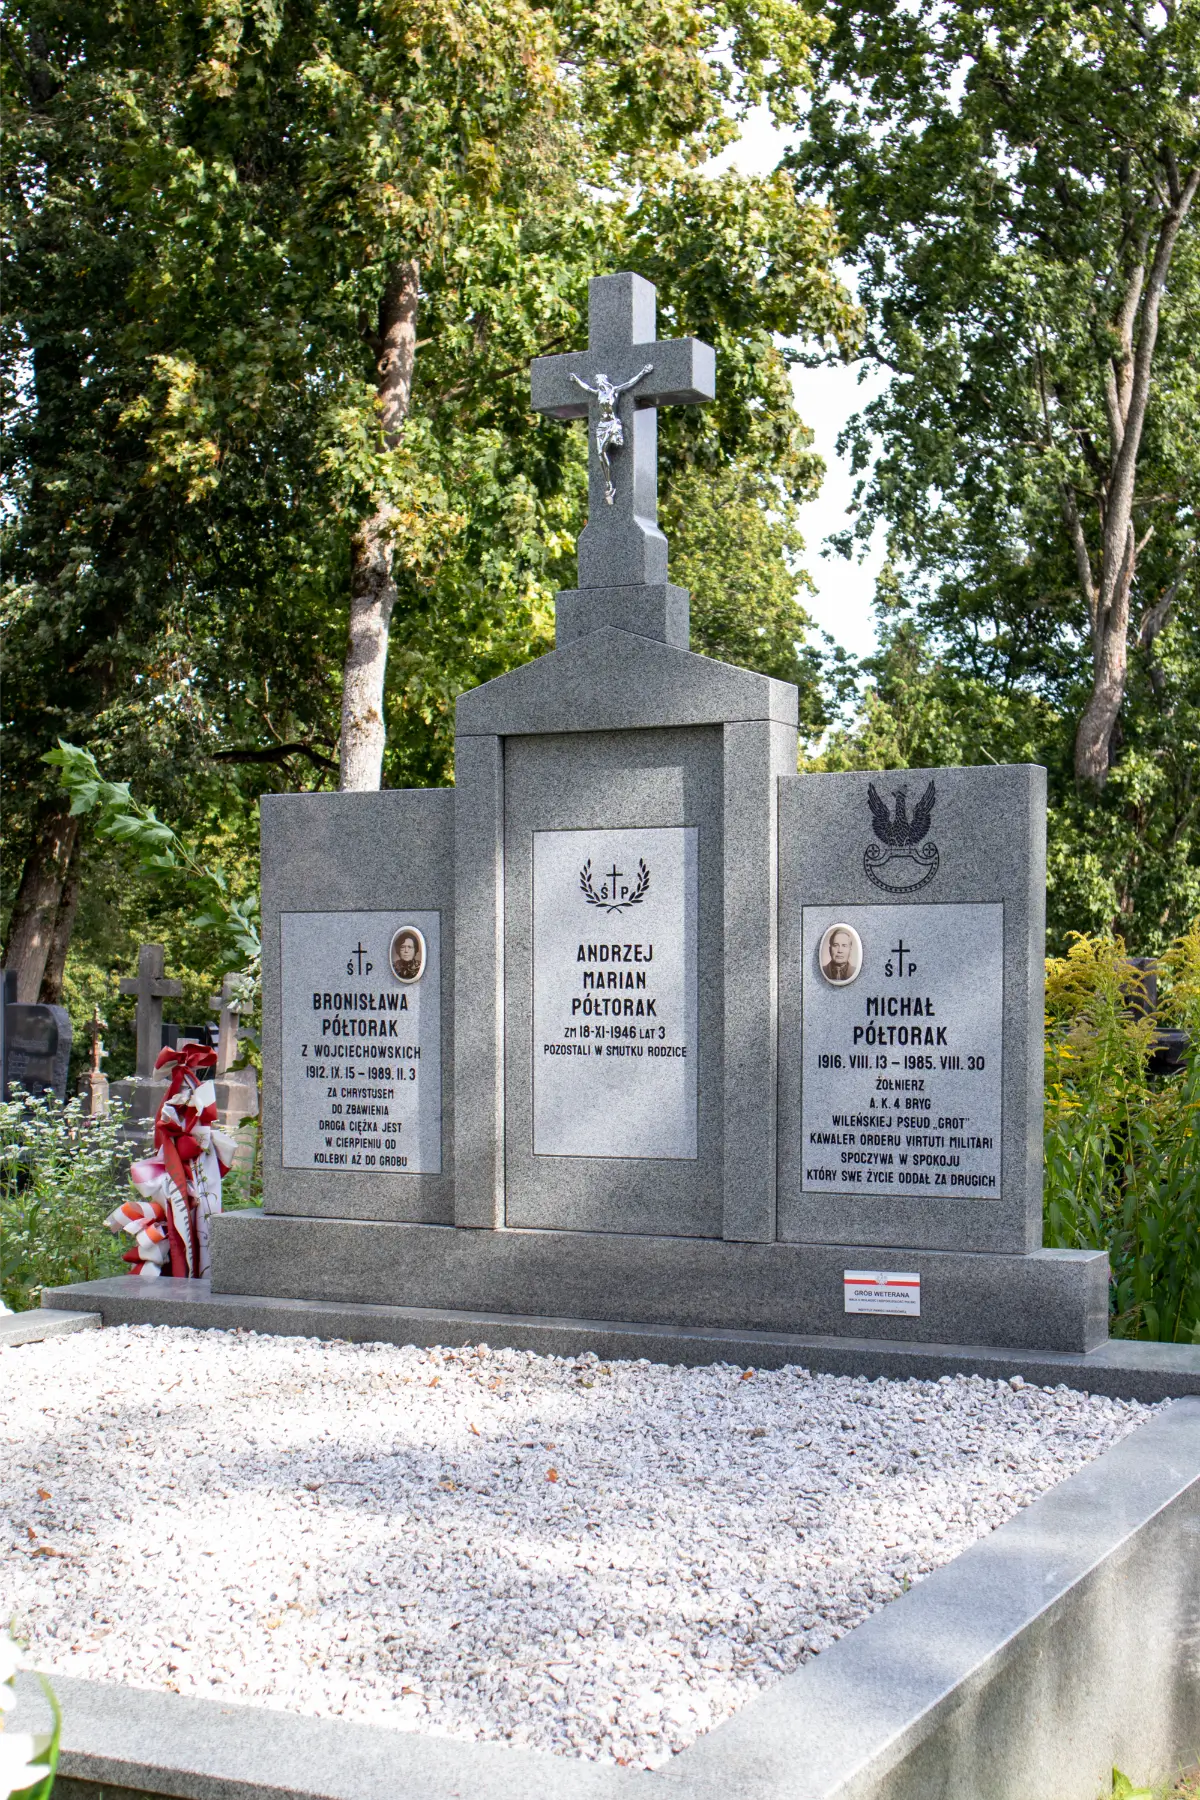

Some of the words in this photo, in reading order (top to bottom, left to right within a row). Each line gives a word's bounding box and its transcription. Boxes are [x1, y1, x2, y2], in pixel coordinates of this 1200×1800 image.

[601, 883, 608, 900] Ś
[621, 887, 629, 899] P
[577, 944, 653, 962] ANDRZEJ
[347, 959, 354, 976] Ś
[366, 963, 373, 976] P
[884, 959, 893, 978] Ś
[908, 964, 917, 977] P
[583, 971, 646, 989] MARIAN
[313, 993, 409, 1012] BRONISŁAWA
[571, 993, 657, 1016] PÓŁTORAK
[866, 997, 935, 1017] MICHAŁ
[322, 1013, 398, 1038] PÓŁTORAK
[564, 1027, 577, 1038] ZM
[579, 1026, 637, 1039] 18-XI-1946
[639, 1028, 655, 1039] LAT
[658, 1026, 666, 1039] 3
[853, 1021, 948, 1046] PÓŁTORAK
[301, 1045, 308, 1057] Z
[314, 1045, 421, 1059] WOJCIECHOWSKICH
[544, 1045, 591, 1056] POZOSTALI
[594, 1045, 603, 1056] W
[606, 1046, 643, 1057] SMUTKU
[648, 1046, 687, 1057] RODZICE
[875, 1056, 887, 1069] 13
[967, 1056, 985, 1070] 30
[345, 1067, 355, 1079] 15
[409, 1068, 416, 1081] 3
[875, 1076, 925, 1091] ŻOŁNIERZ
[327, 1088, 337, 1097] ZA
[341, 1088, 394, 1100] CHRYSTUSEM
[331, 1105, 342, 1114] DO
[346, 1105, 389, 1116] ZBAWIENIA
[893, 1099, 900, 1109] 4
[905, 1099, 931, 1110] BRYG
[319, 1120, 345, 1131] DROGA
[349, 1120, 378, 1135] CIĘŻKA
[382, 1122, 402, 1133] JEST
[832, 1112, 893, 1128] WILEŃSKIEJ
[897, 1117, 930, 1129] PSEUD
[325, 1137, 332, 1147] W
[336, 1137, 381, 1149] CIERPIENIU
[385, 1139, 396, 1150] OD
[810, 1133, 855, 1146] KAWALER
[860, 1134, 901, 1147] ORDERU
[906, 1135, 945, 1148] VIRTUTI
[949, 1136, 993, 1149] MILITARI
[314, 1153, 348, 1164] KOLEBKI
[351, 1152, 361, 1165] AŻ
[365, 1155, 376, 1165] DO
[379, 1155, 408, 1167] GROBU
[841, 1152, 893, 1165] SPOCZYWA
[899, 1154, 908, 1165] W
[912, 1154, 960, 1167] SPOKOJU
[807, 1169, 837, 1181] KTÓRY
[841, 1171, 862, 1182] SWE
[866, 1169, 894, 1184] ŻYCIE
[898, 1172, 931, 1185] ODDAŁ
[935, 1173, 947, 1185] ZA
[950, 1174, 996, 1187] DRUGICH
[854, 1289, 872, 1297] GRÓB
